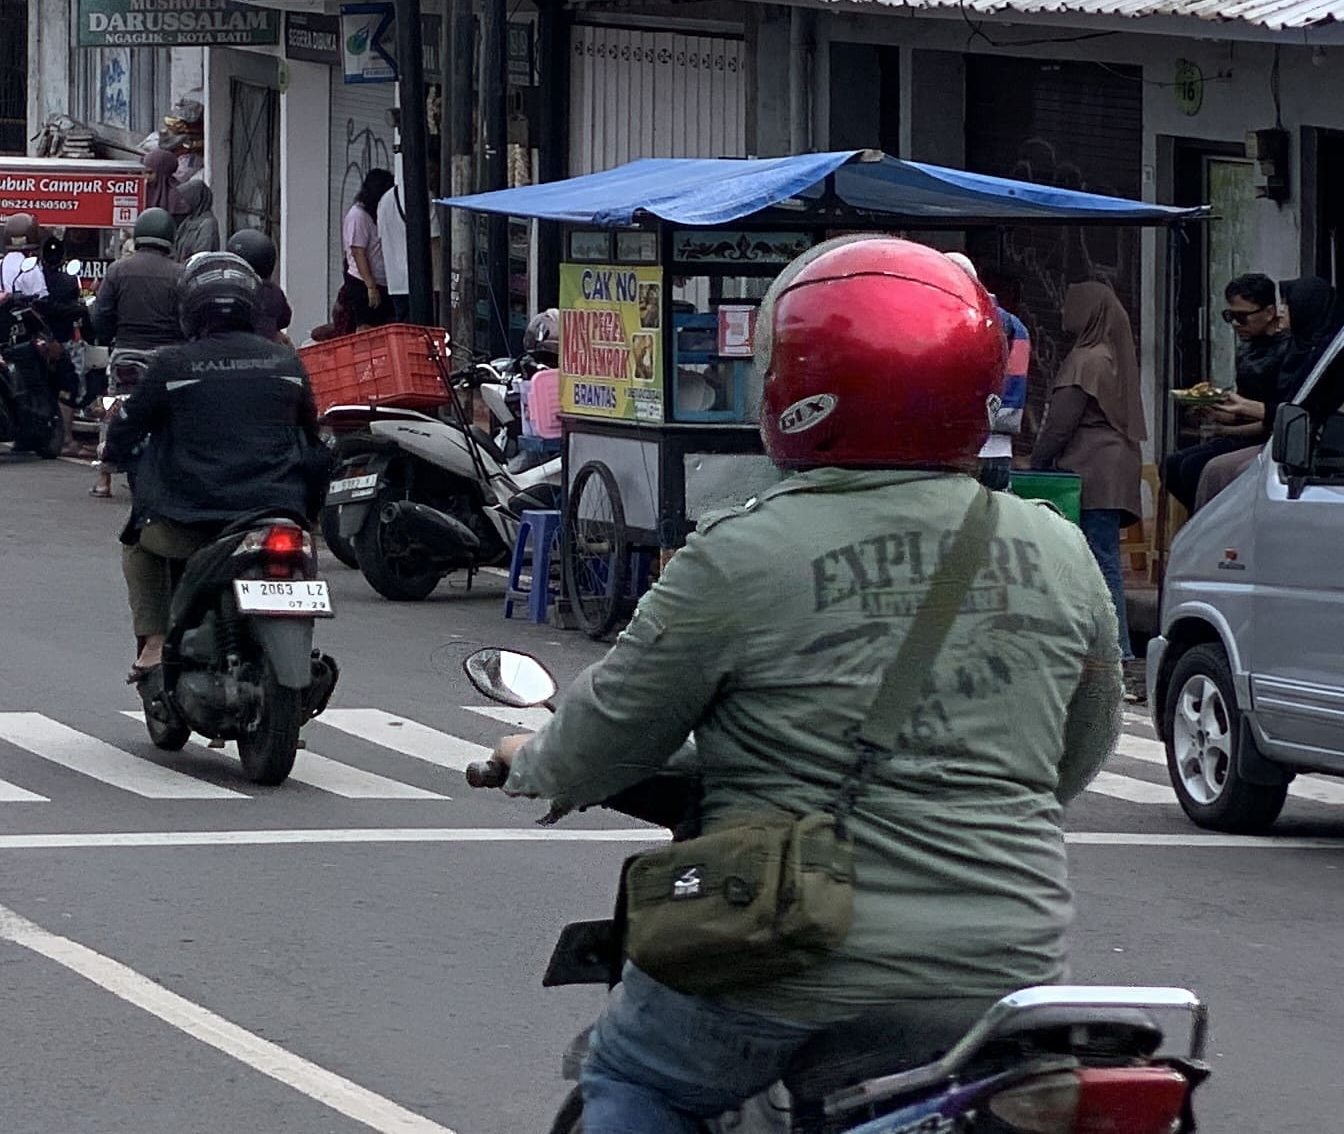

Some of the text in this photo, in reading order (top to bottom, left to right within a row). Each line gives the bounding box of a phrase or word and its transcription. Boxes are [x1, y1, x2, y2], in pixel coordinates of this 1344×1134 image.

[88, 11, 269, 32] DARUSSALAM
[105, 32, 164, 44] NGAGLIK
[177, 32, 213, 44] KOTA
[581, 269, 638, 303] CAK NO
[573, 383, 617, 409] BRANTAS
[306, 583, 324, 596] LZ
